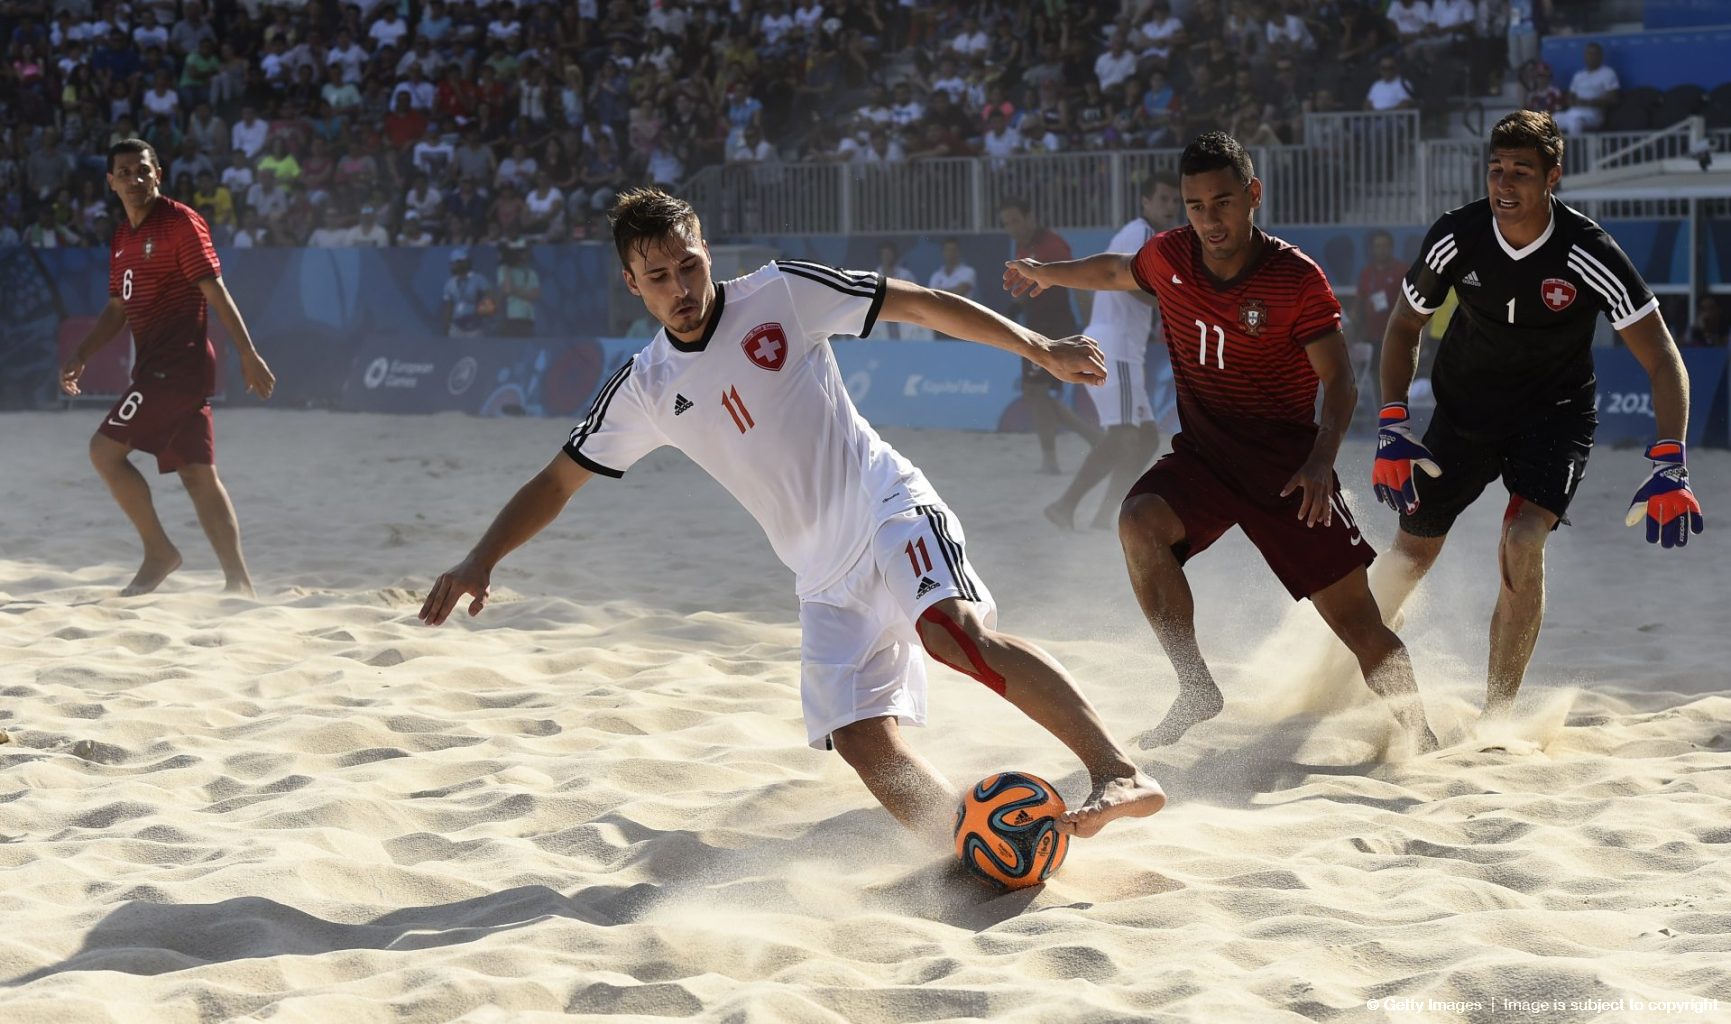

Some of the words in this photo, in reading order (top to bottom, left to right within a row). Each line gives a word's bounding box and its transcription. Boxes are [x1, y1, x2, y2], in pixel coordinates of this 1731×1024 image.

[122, 269, 133, 300] 6
[1506, 297, 1516, 324] 1
[1195, 319, 1225, 370] 11
[118, 391, 143, 421] 6
[675, 400, 694, 416] adidas
[721, 384, 755, 434] 11
[1564, 459, 1575, 495] 1
[904, 536, 933, 578] 11
[915, 582, 941, 600] adidas
